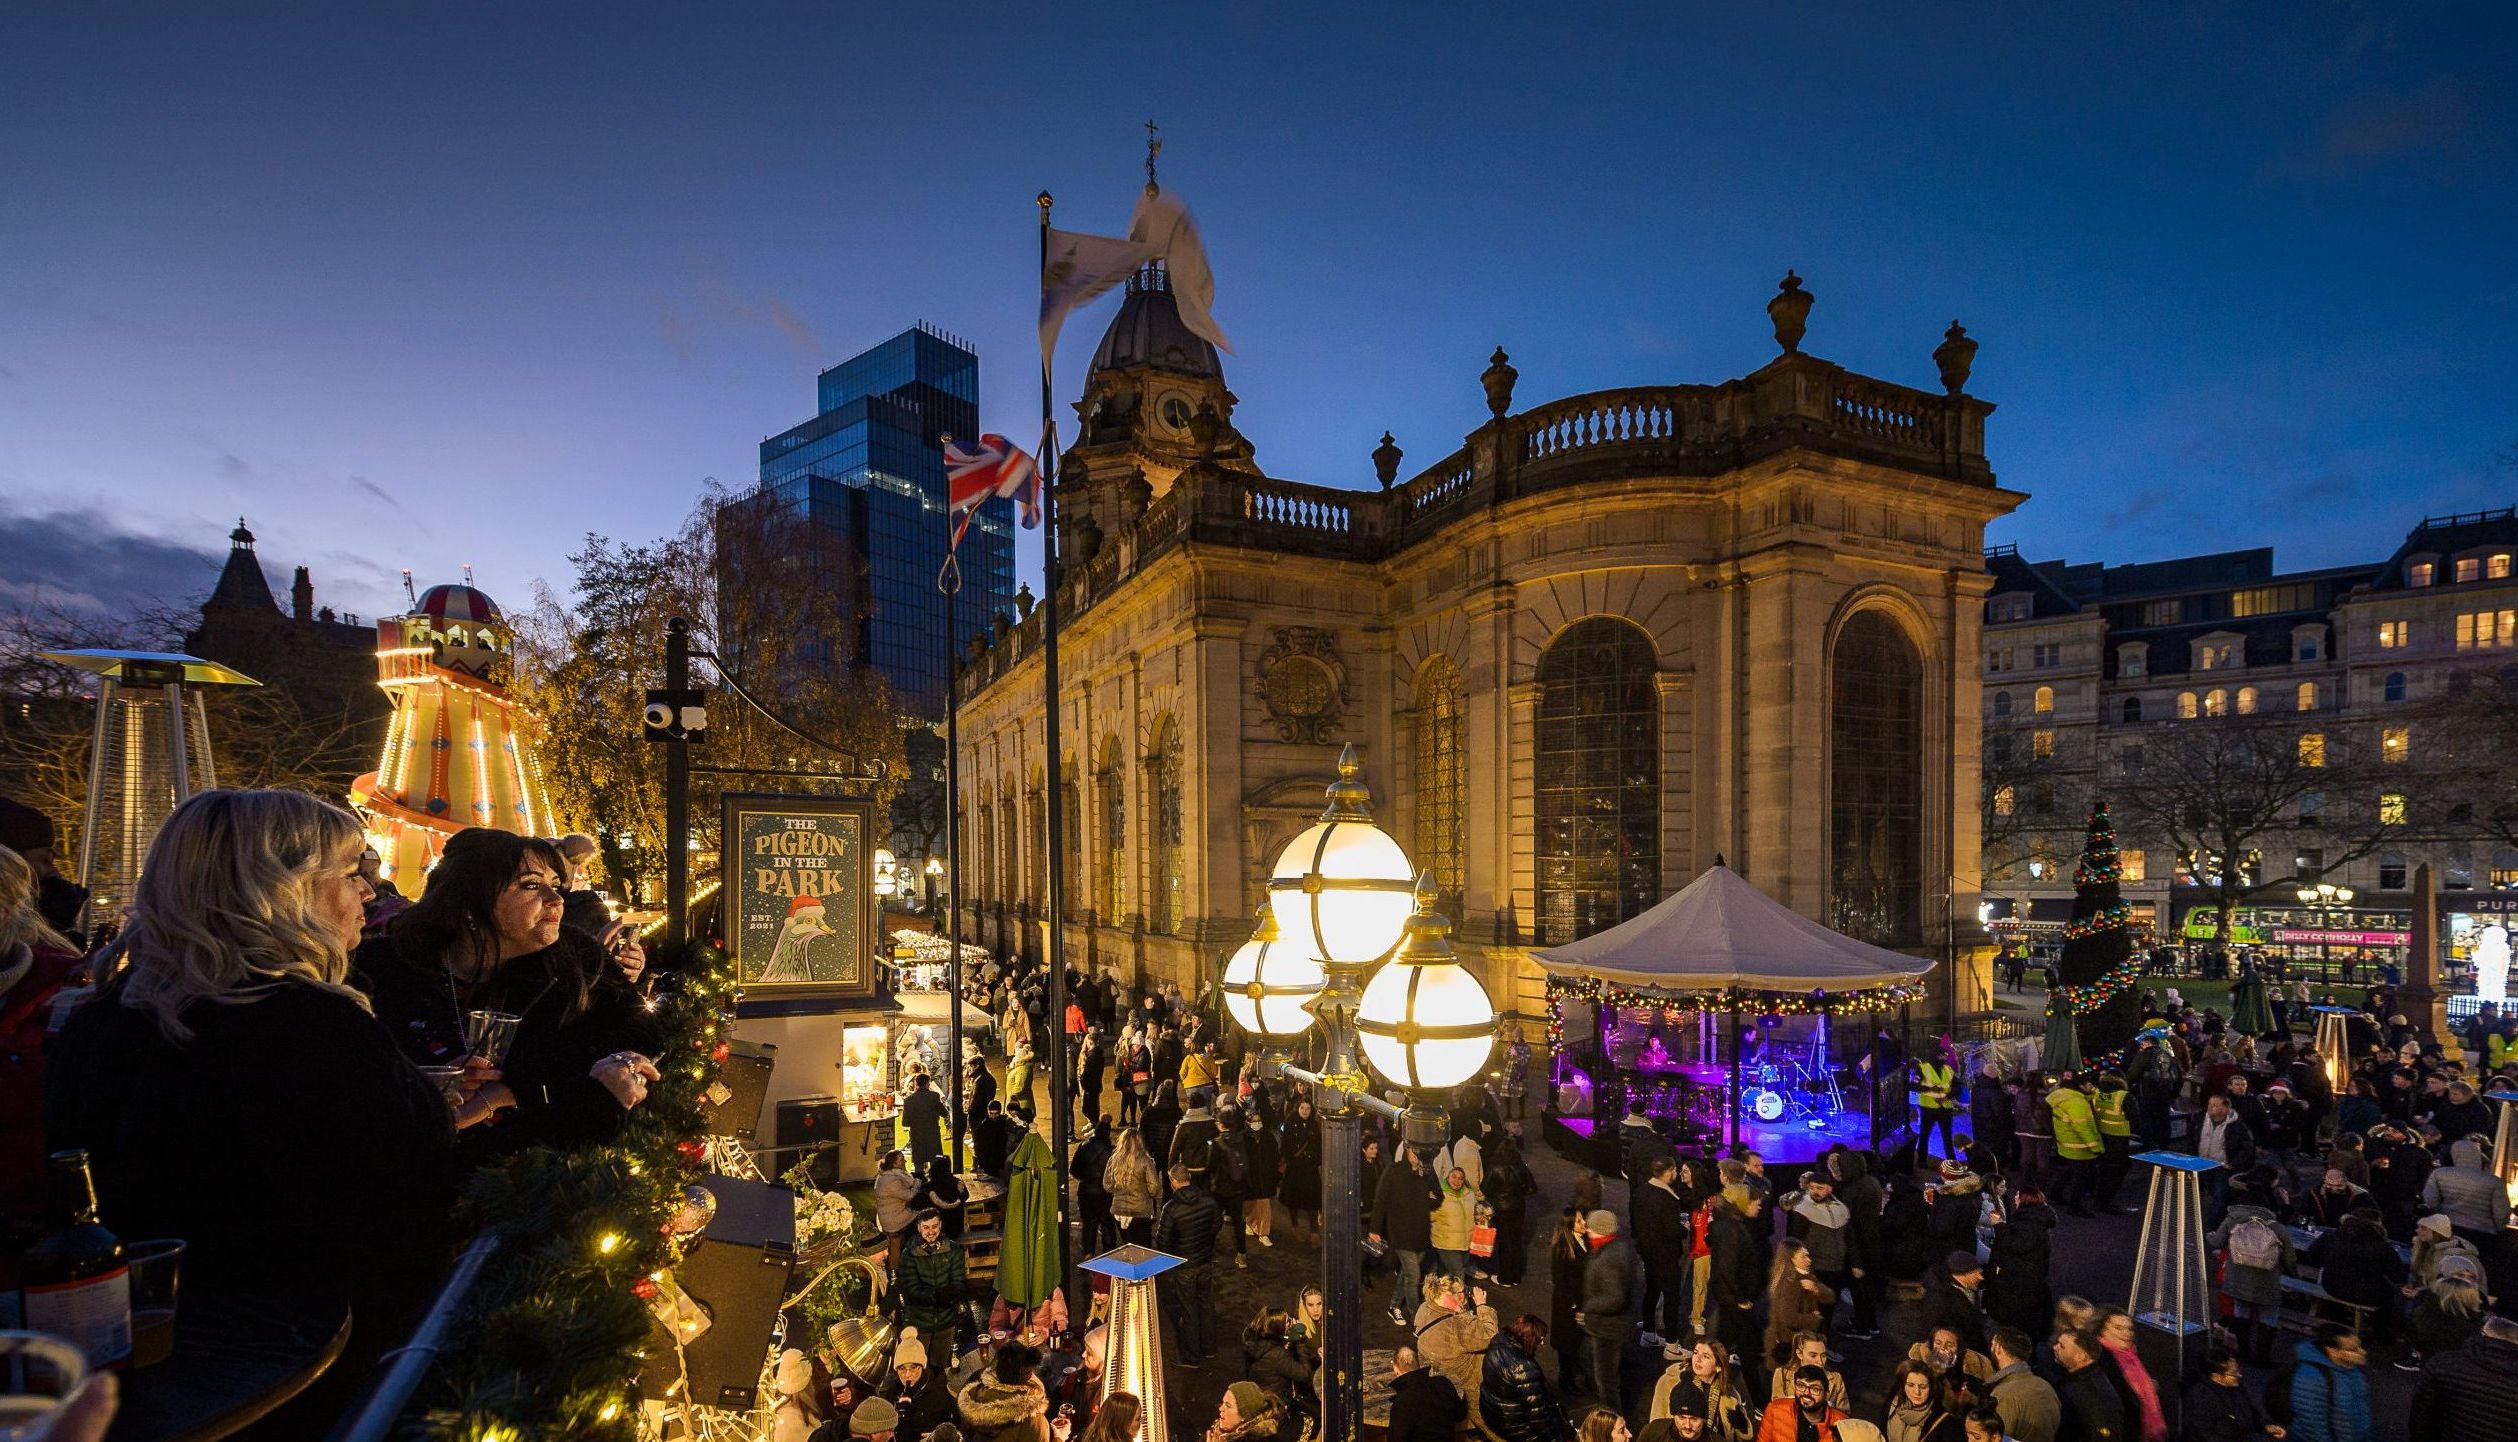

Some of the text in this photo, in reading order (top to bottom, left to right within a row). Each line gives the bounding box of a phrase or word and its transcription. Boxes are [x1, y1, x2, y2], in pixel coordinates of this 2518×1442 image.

[784, 818, 817, 829] THE
[754, 830, 847, 856] PIGEON
[773, 856, 828, 868] IN THE
[755, 867, 844, 898] PARK
[750, 914, 774, 922] EST.
[749, 922, 774, 930] 2021
